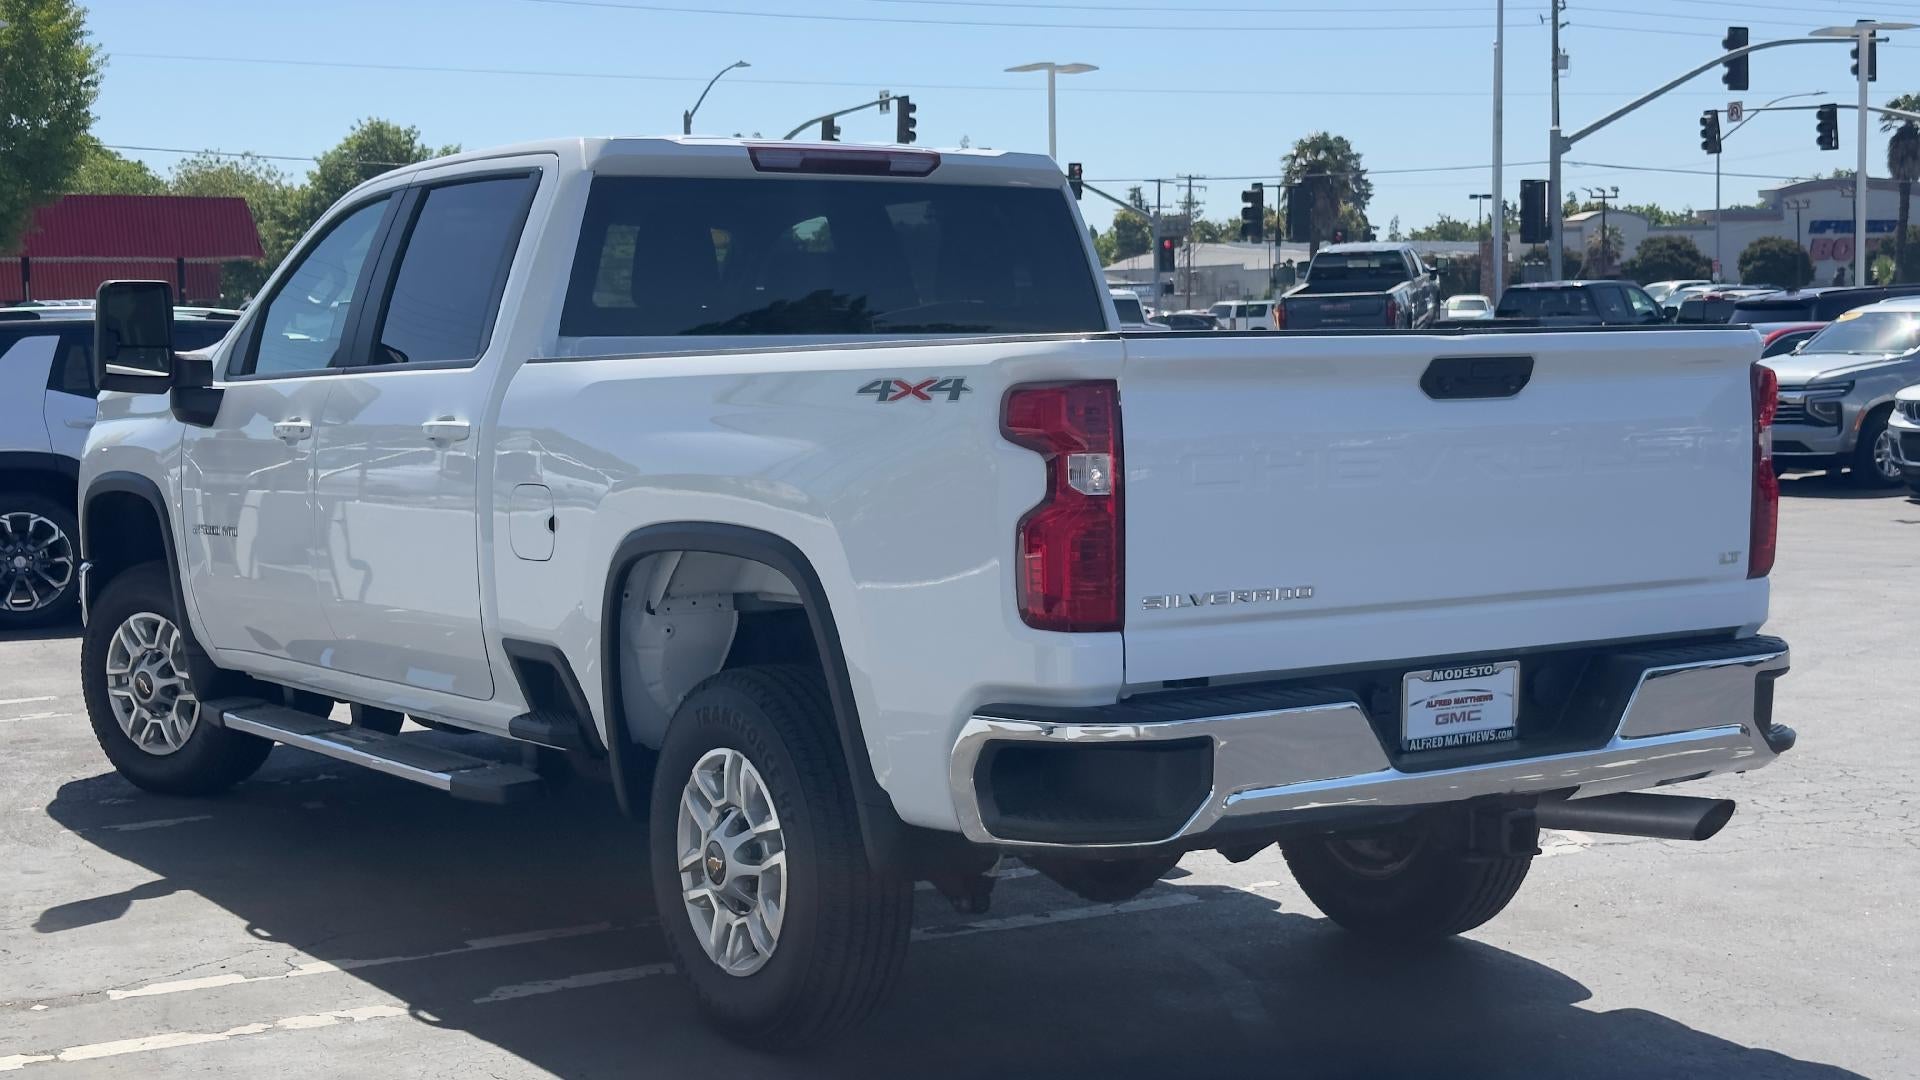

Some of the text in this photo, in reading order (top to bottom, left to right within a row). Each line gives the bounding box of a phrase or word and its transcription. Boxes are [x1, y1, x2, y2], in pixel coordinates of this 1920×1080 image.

[1142, 586, 1314, 610] SILVERADO
[1432, 665, 1493, 681] MODESTO
[1425, 698, 1453, 709] ALFRED
[1453, 693, 1494, 705] MATTHEWS
[1435, 709, 1482, 726] GMC
